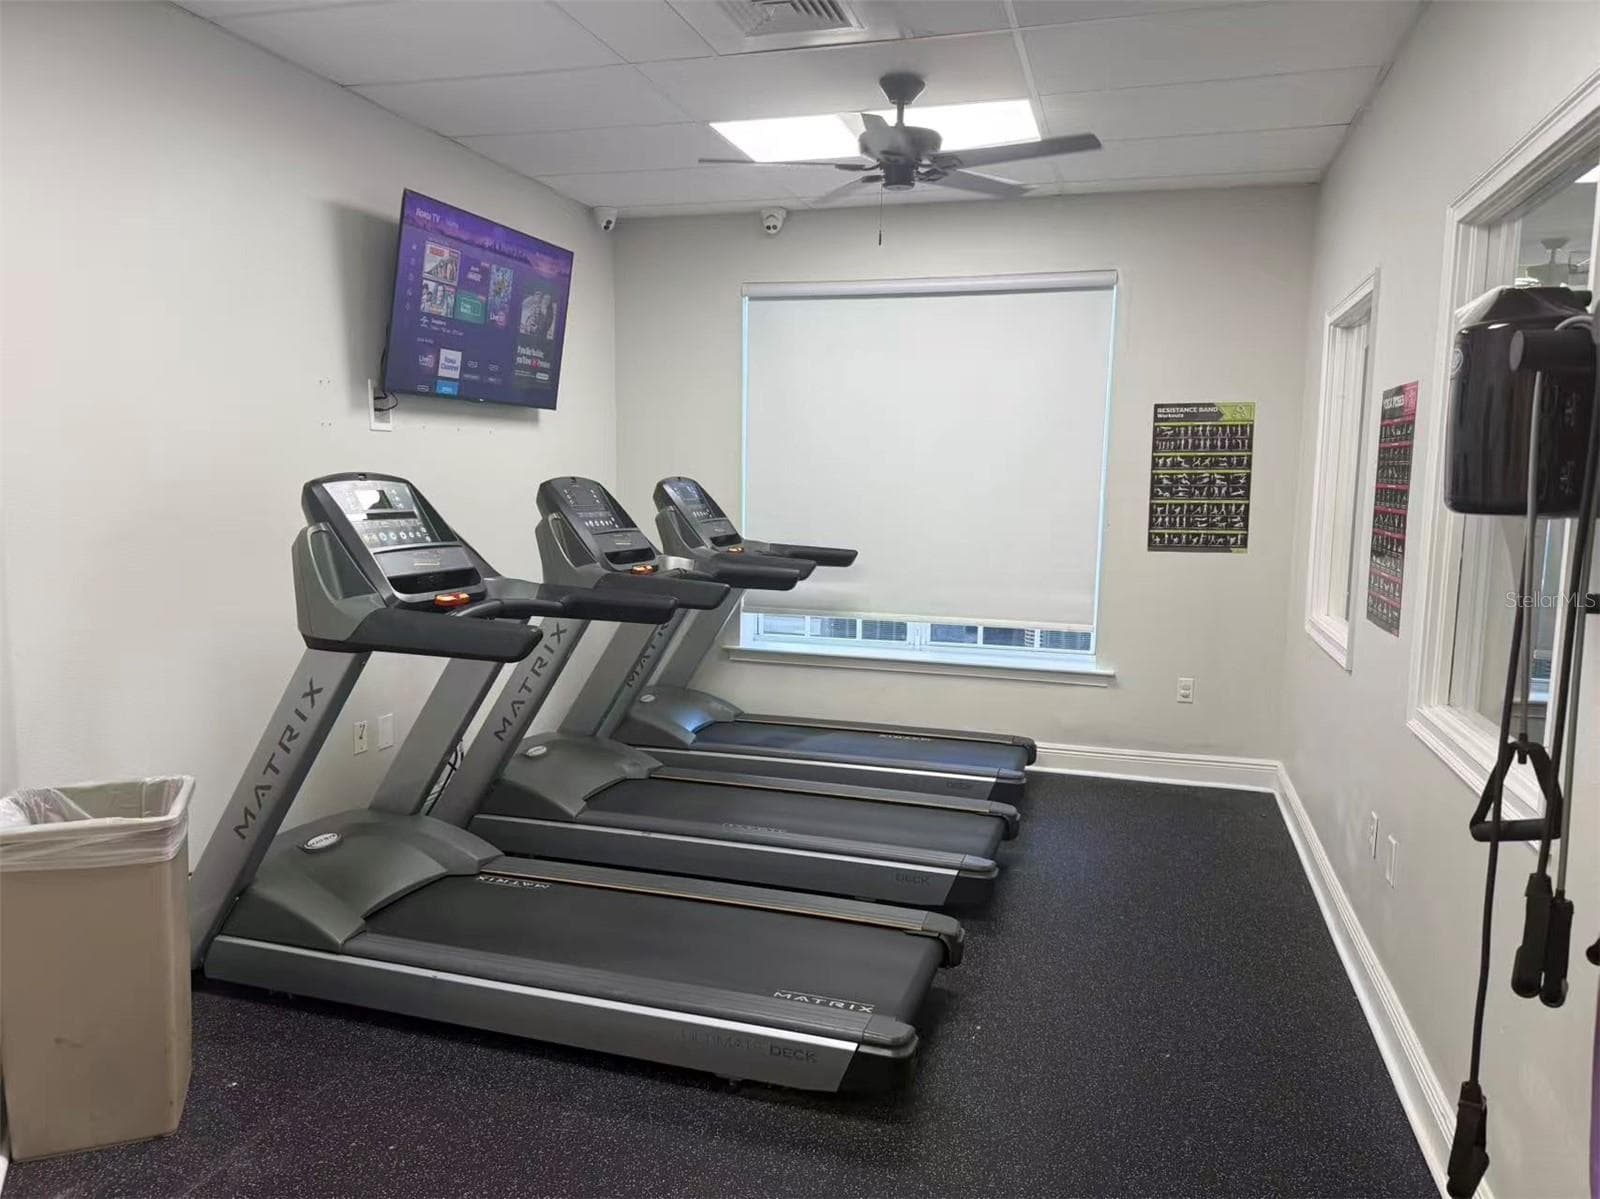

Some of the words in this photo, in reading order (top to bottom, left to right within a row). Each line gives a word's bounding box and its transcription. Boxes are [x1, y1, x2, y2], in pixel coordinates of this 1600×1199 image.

[493, 622, 568, 741] MATRIX
[233, 678, 324, 841] MATRIX
[773, 990, 874, 1013] MATRIX
[769, 1043, 818, 1064] DECK
